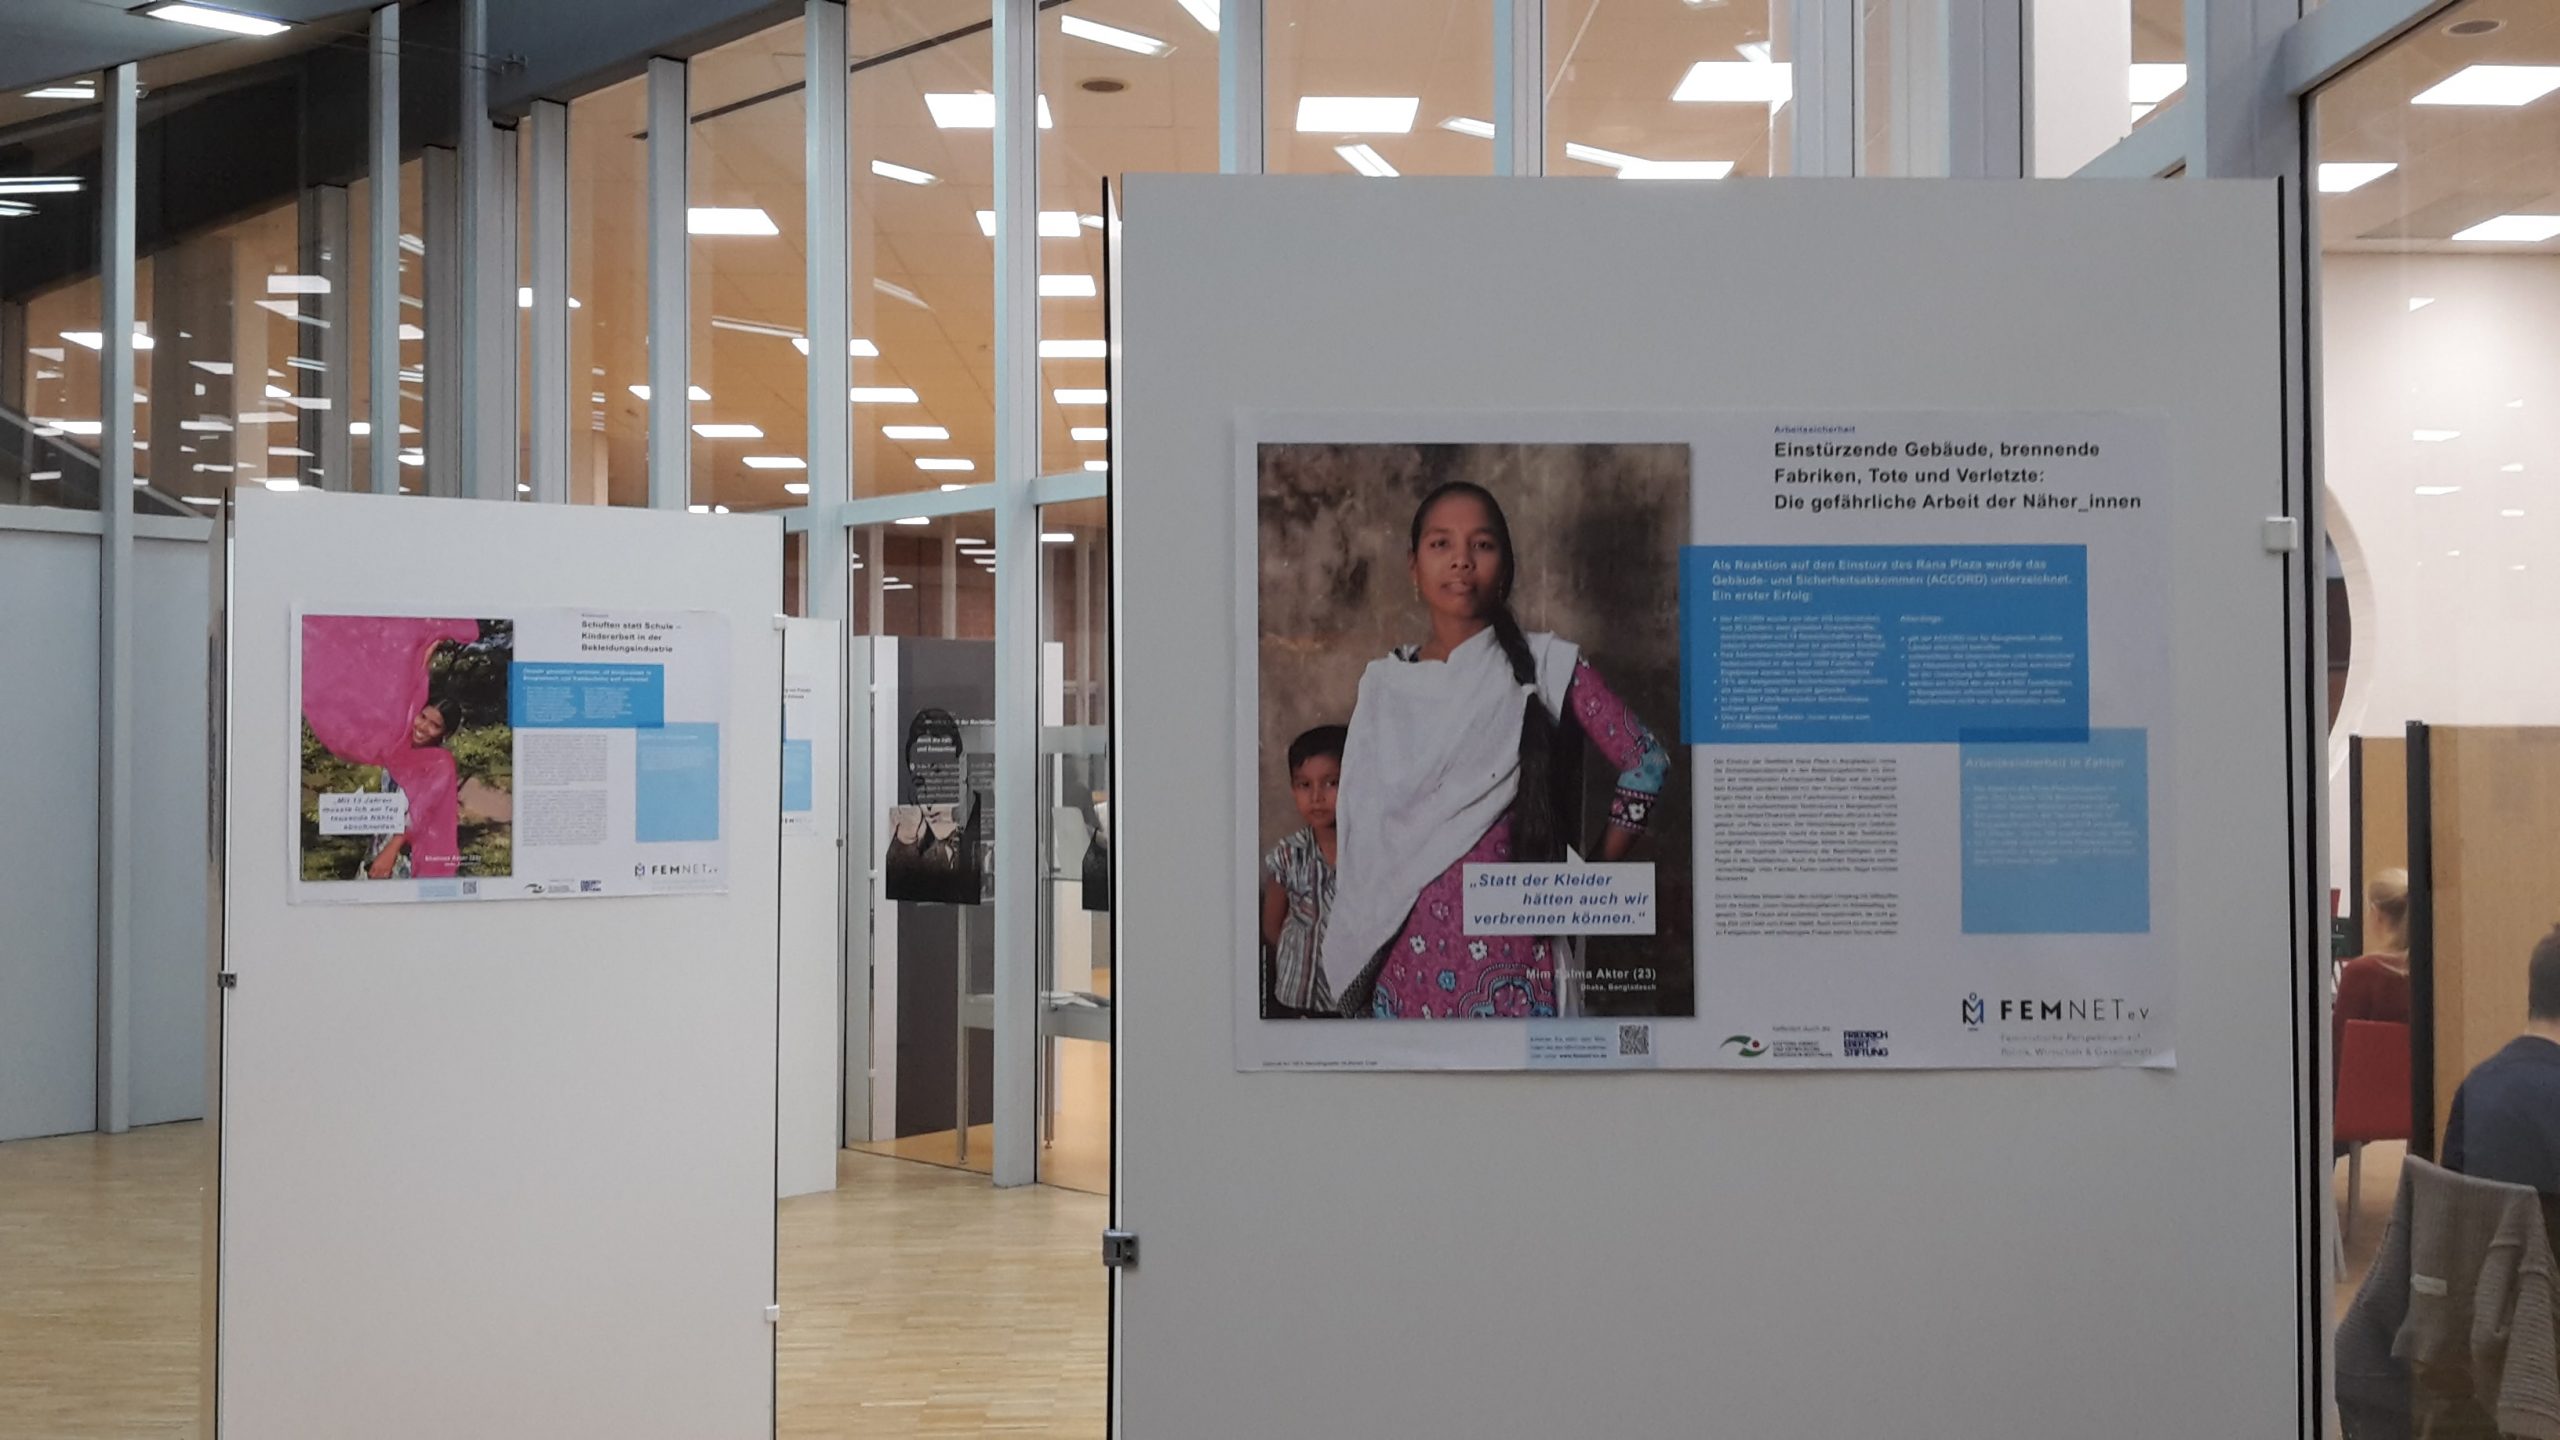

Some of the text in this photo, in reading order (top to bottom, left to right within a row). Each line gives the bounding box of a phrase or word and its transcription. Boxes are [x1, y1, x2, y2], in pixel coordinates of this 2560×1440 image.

[1774, 441, 2100, 459] Einstürzende Gebäude, brennende
[1774, 468, 2045, 484] Fabriken, Tote und Verletzte:
[1774, 493, 2142, 513] Die gefährliche Arbeit der Näher_innen
[1712, 559, 2047, 570] Als Reaktion auf den Einsturz des Rana Plaza wurde das
[1770, 575, 1792, 586] und
[1796, 575, 1923, 586] Sicherheitsabkommen
[1926, 574, 1988, 587] (ACCORD)
[1712, 590, 1731, 600] Ein
[1735, 590, 1769, 600] erster
[644, 622, 674, 630] Schule
[581, 644, 673, 653] Bekleidungsindustrie
[652, 863, 707, 875] FEMNET
[1470, 874, 1612, 888] „Statt der Kleider
[1523, 893, 1649, 905] hätten auch wir
[1474, 911, 1646, 924] verbrennen können.“
[1526, 968, 1551, 979] Mim
[1596, 968, 1628, 979] Akter
[1633, 968, 1656, 981] (23)
[2001, 998, 2125, 1021] FEMNET
[1843, 1030, 1888, 1039] FRIEDRICH
[1843, 1048, 1889, 1057] STIFTUNG
